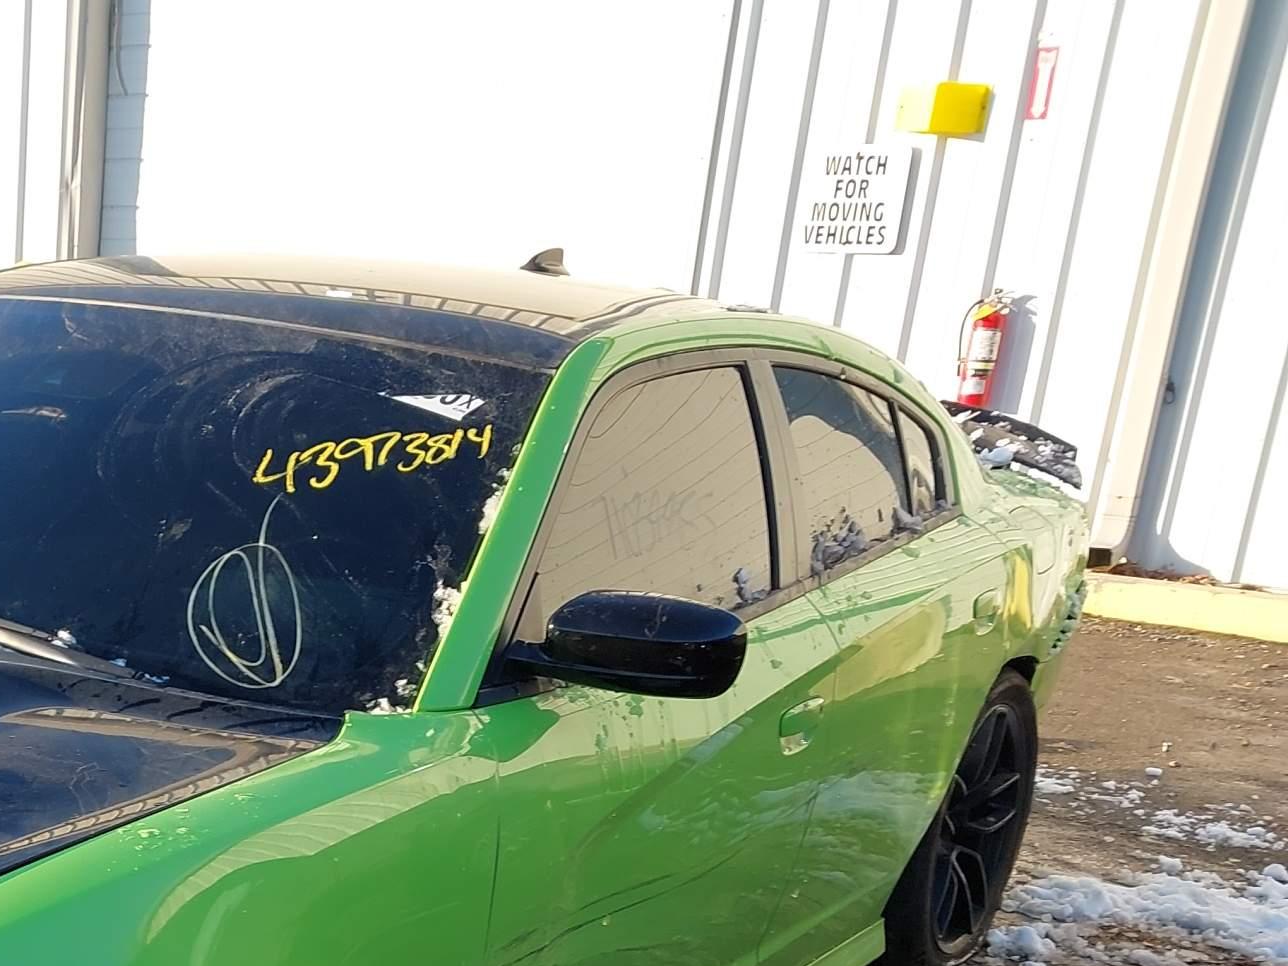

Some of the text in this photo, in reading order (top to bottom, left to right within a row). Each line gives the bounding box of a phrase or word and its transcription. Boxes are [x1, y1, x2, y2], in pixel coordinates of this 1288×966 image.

[826, 155, 888, 175] WATCH
[834, 179, 869, 198] FOR
[811, 202, 884, 221] MOVING
[804, 225, 886, 245] VEHICLES
[251, 424, 494, 494] 43973814
